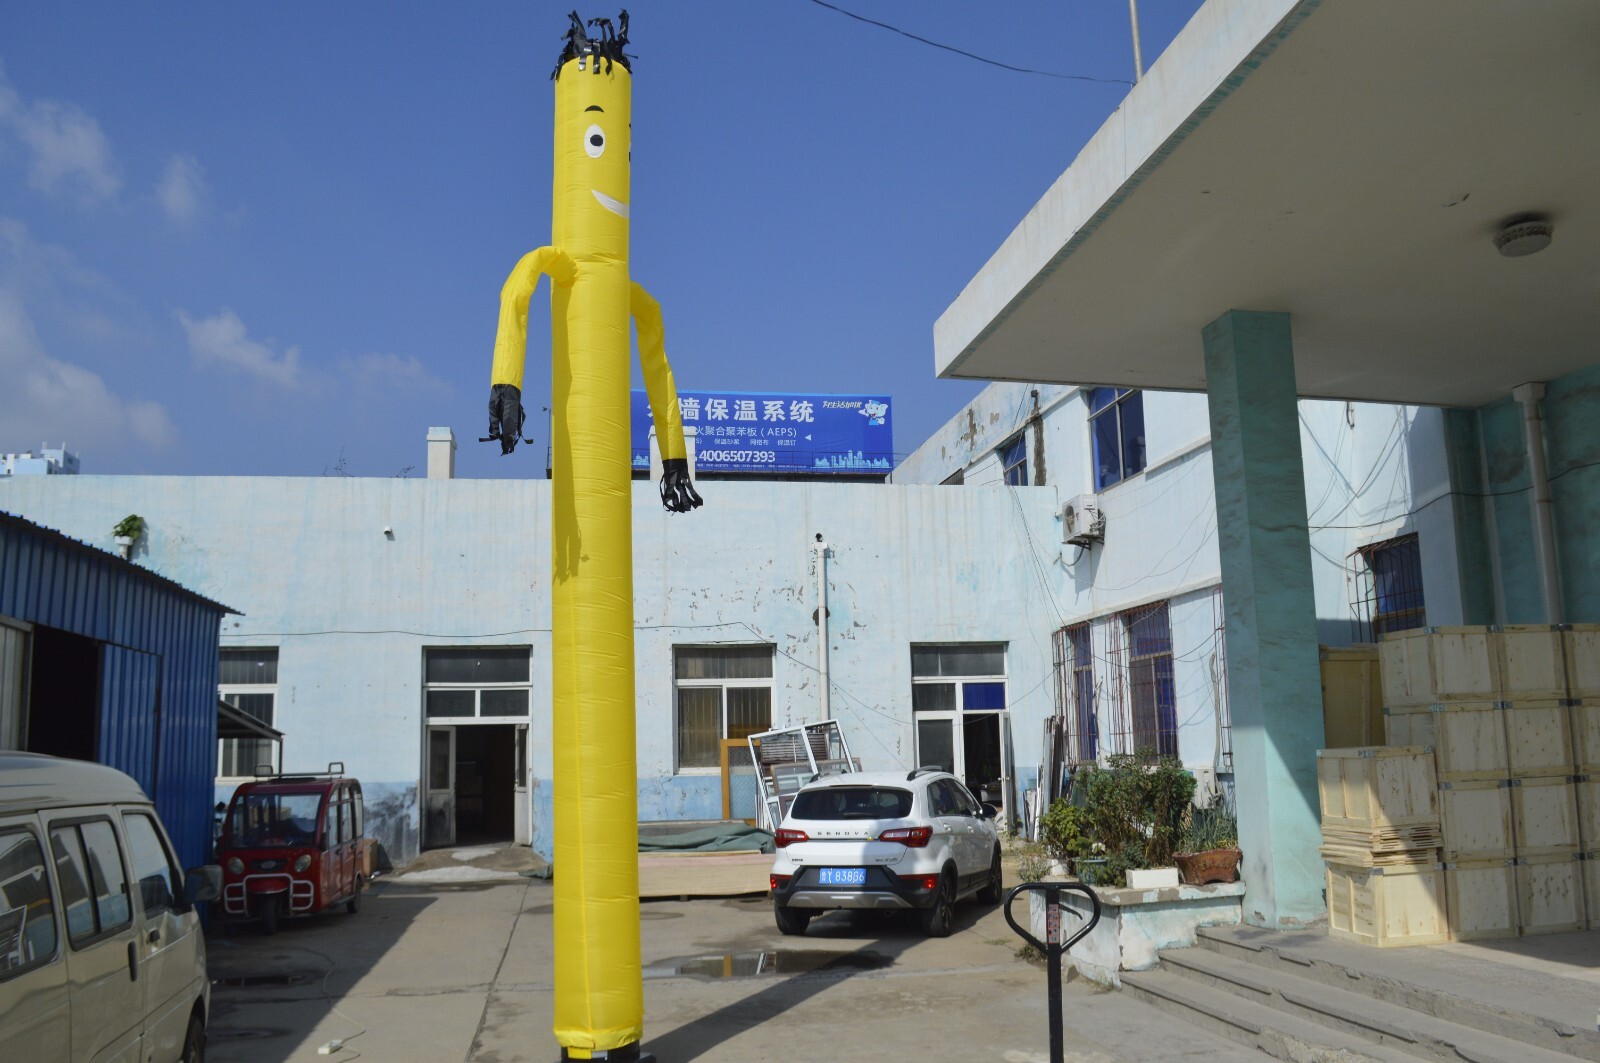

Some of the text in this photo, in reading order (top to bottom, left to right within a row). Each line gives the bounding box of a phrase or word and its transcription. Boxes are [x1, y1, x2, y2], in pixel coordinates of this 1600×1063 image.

[647, 397, 815, 423] 墙保温系统
[699, 450, 776, 463] 4006507393
